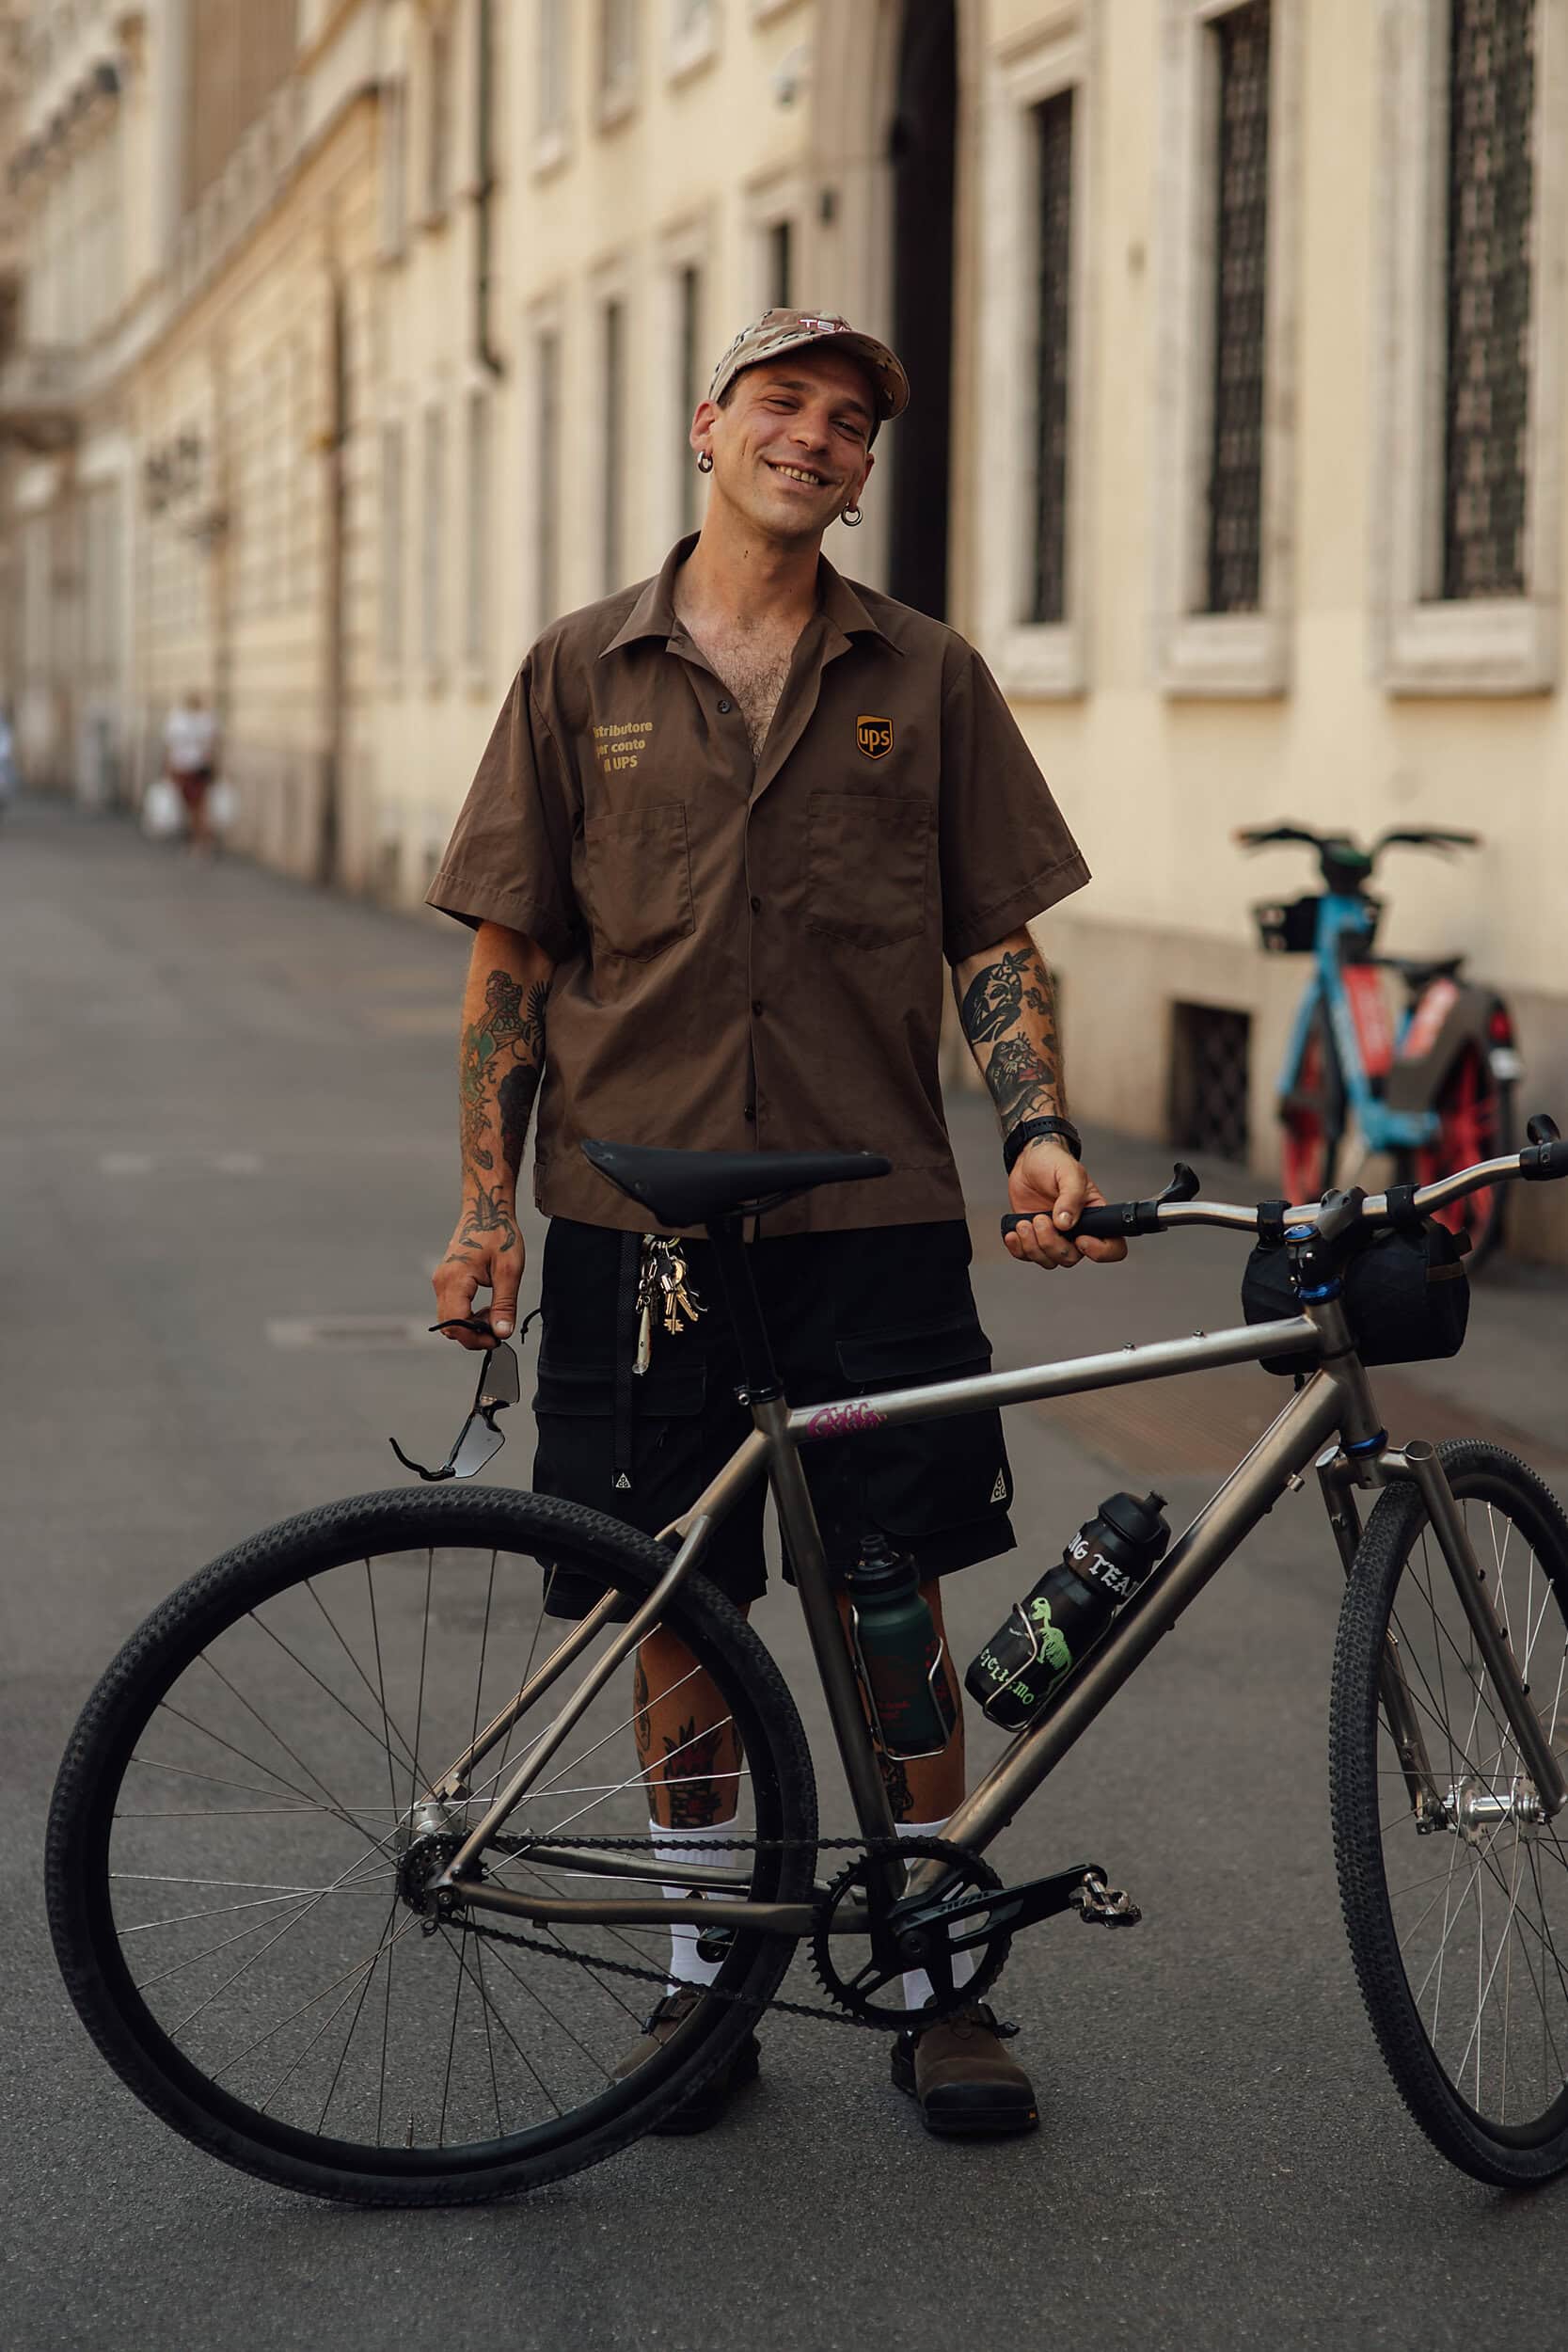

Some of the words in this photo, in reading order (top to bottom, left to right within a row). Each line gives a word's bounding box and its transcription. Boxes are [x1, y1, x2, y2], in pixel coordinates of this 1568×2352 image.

[610, 739, 646, 753] conto
[859, 727, 890, 752] ups
[612, 755, 638, 770] UPS
